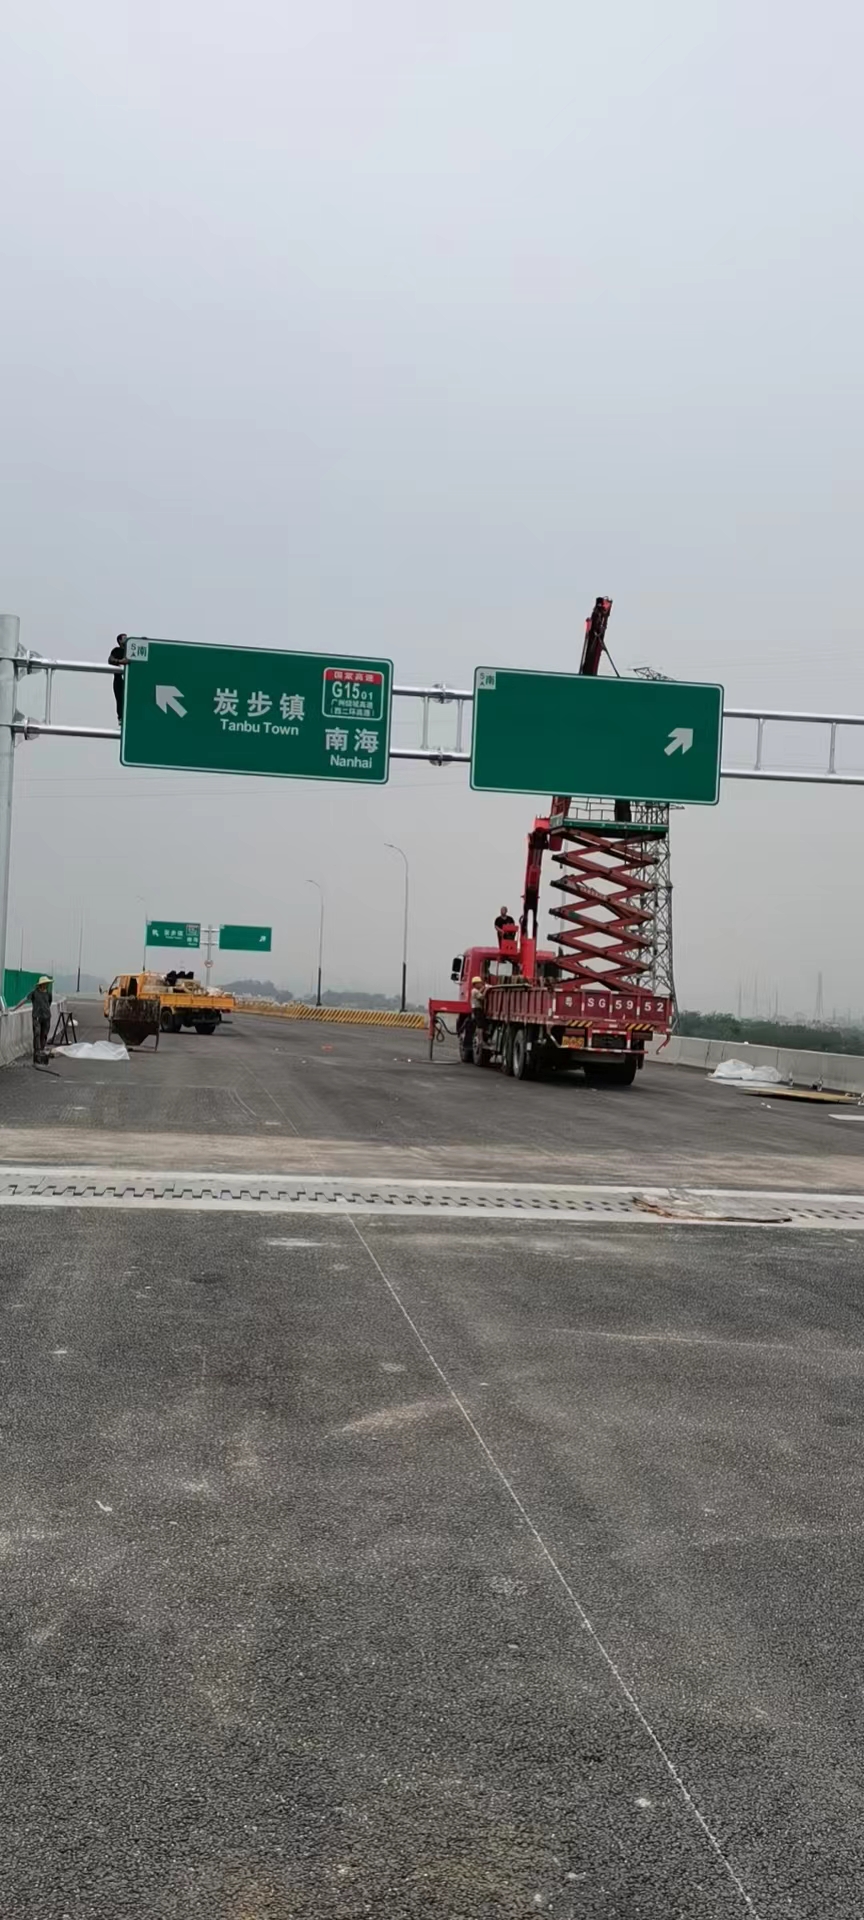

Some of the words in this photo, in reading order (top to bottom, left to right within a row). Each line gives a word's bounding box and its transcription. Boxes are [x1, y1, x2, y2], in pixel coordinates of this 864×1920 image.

[213, 688, 305, 721] 炭步镇
[220, 718, 260, 733] Tanbu
[262, 721, 299, 736] Town
[325, 726, 379, 753] 南海
[330, 754, 373, 769] Nanhai
